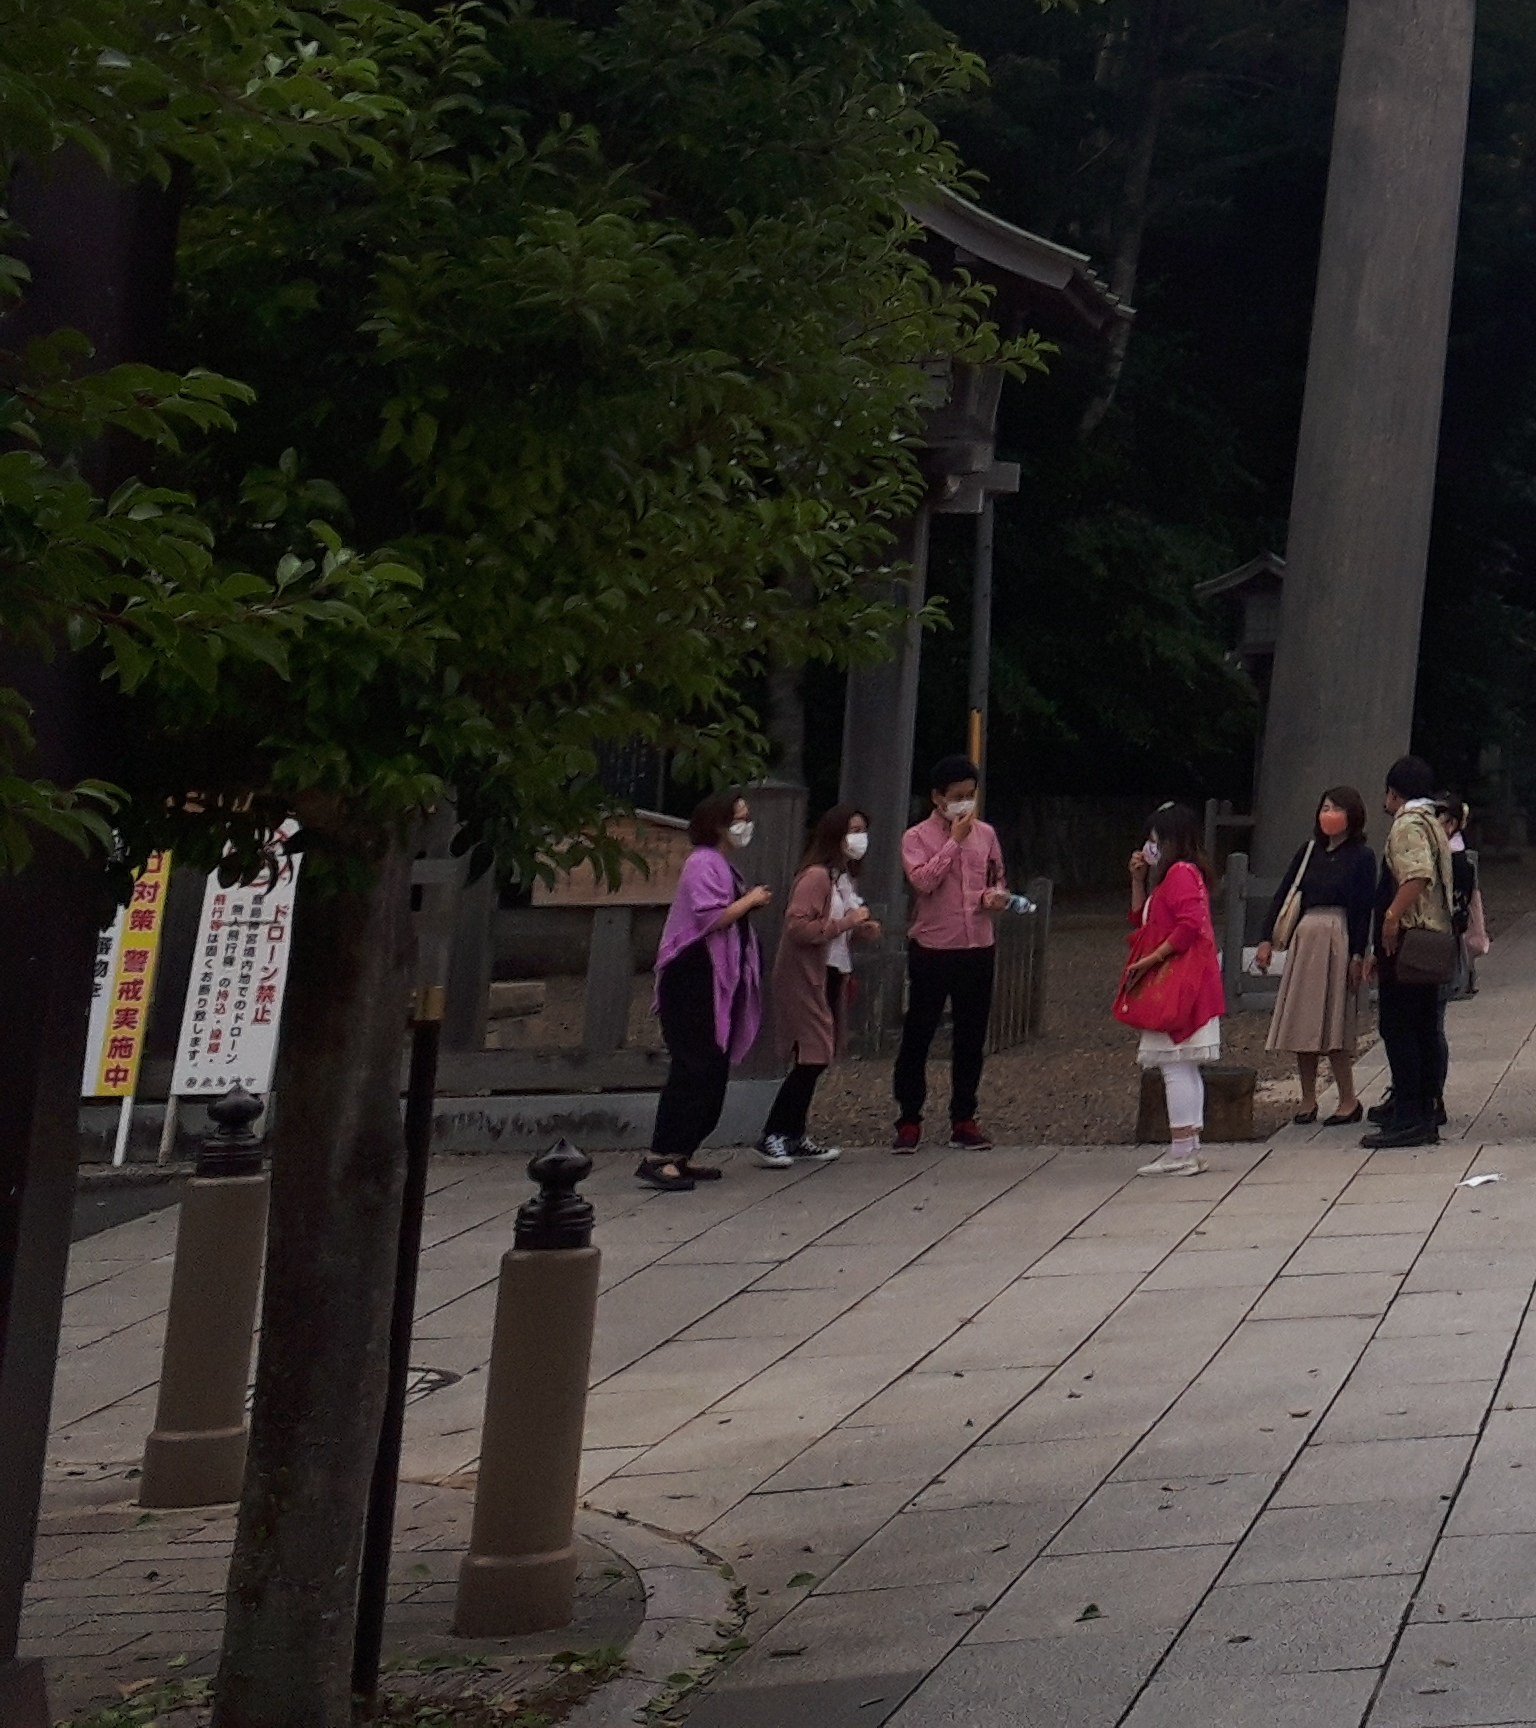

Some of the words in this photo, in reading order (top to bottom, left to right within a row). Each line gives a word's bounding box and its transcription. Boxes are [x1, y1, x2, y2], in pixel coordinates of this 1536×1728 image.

[104, 949, 150, 1089] 警戒実施中
[251, 904, 289, 1025] ドローン禁止
